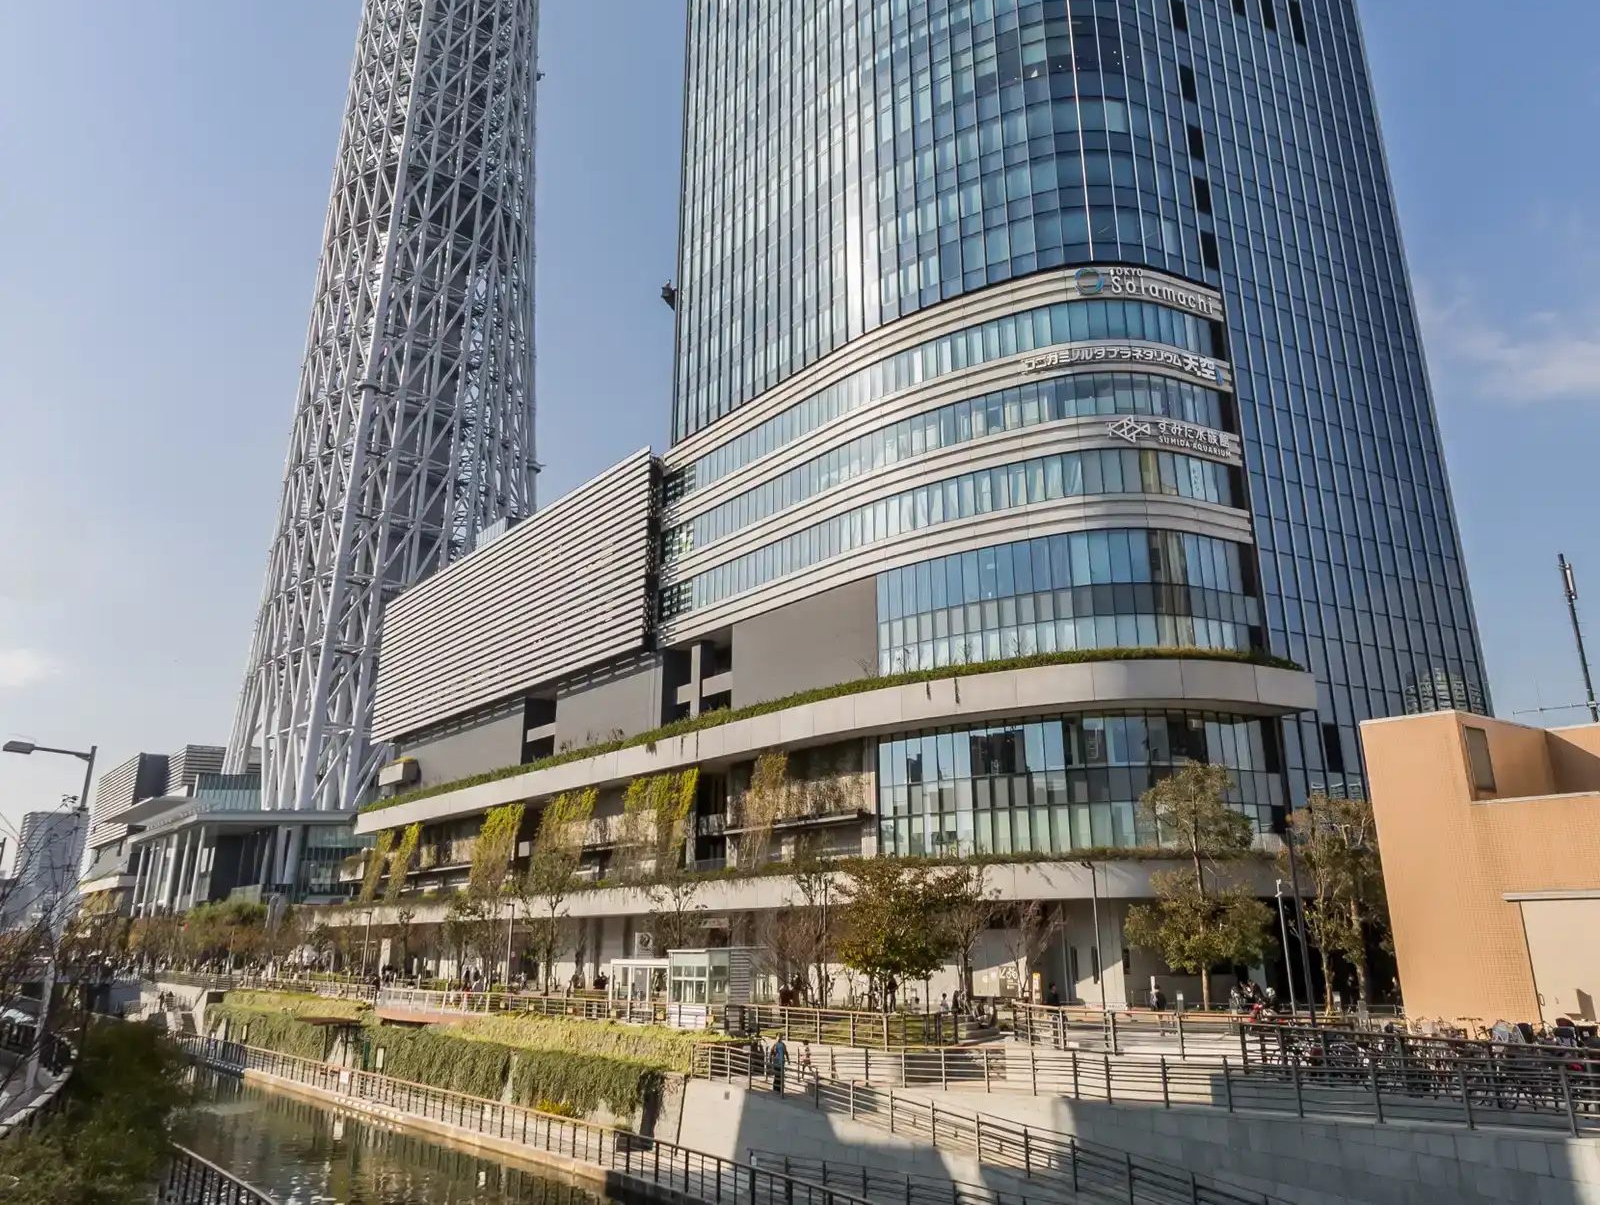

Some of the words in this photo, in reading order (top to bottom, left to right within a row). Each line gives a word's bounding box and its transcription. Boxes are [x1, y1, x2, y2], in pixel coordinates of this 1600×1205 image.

[1110, 267, 1143, 277] TOKYO
[1111, 276, 1213, 314] Solamachi
[1159, 436, 1191, 448] SUMIDA
[1192, 442, 1231, 457] AQUARIUM
